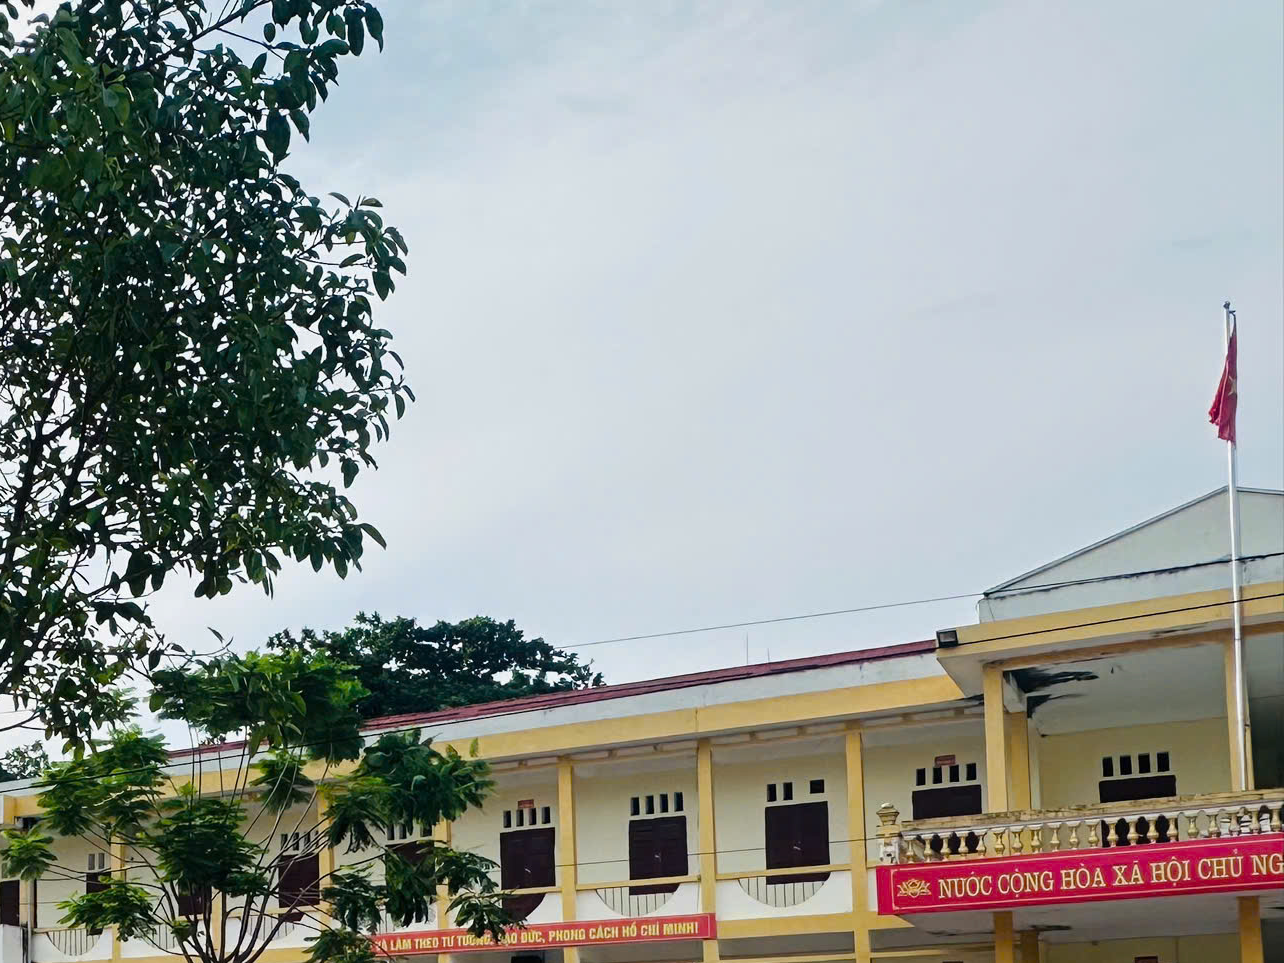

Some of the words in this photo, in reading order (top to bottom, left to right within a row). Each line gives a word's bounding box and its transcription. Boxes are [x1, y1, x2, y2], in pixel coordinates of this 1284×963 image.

[938, 871, 993, 899] NƯỚC
[998, 868, 1055, 898] CỘNG
[1060, 863, 1106, 890] HÒA
[1113, 860, 1145, 886] XÃ
[1150, 856, 1191, 887] HỘI
[1198, 848, 1244, 879] CHỦ
[415, 937, 439, 950] THEO
[548, 928, 586, 942] PHONG
[589, 925, 619, 939] CÁCH
